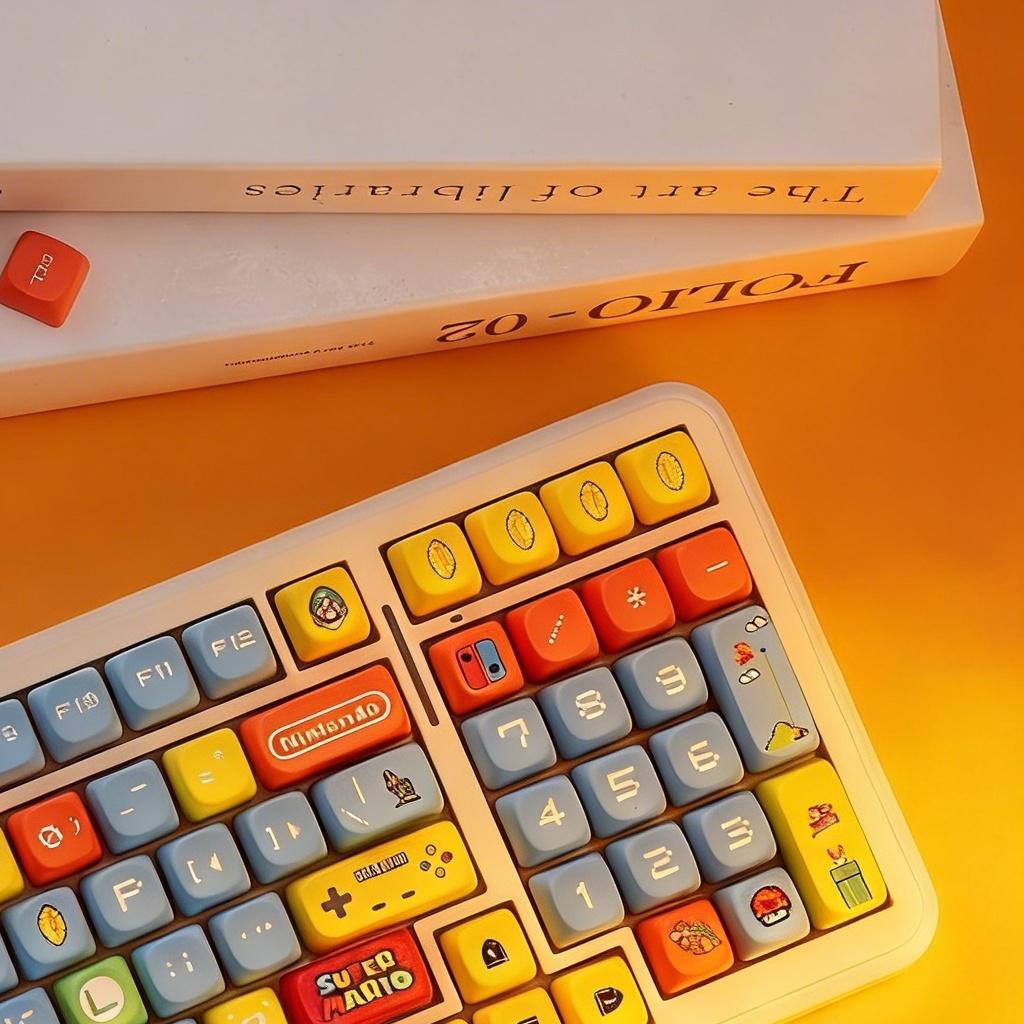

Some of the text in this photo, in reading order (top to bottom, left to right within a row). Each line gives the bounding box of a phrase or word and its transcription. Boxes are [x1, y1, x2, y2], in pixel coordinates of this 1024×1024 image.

[244, 184, 864, 203] The art of libraries
[586, 260, 869, 320] FOLIO
[436, 312, 528, 343] 02
[497, 718, 530, 748] 7
[607, 765, 641, 803] 5
[538, 797, 566, 828] 4
[643, 845, 680, 880] 2
[576, 881, 596, 911] 1
[83, 989, 119, 1017] L
